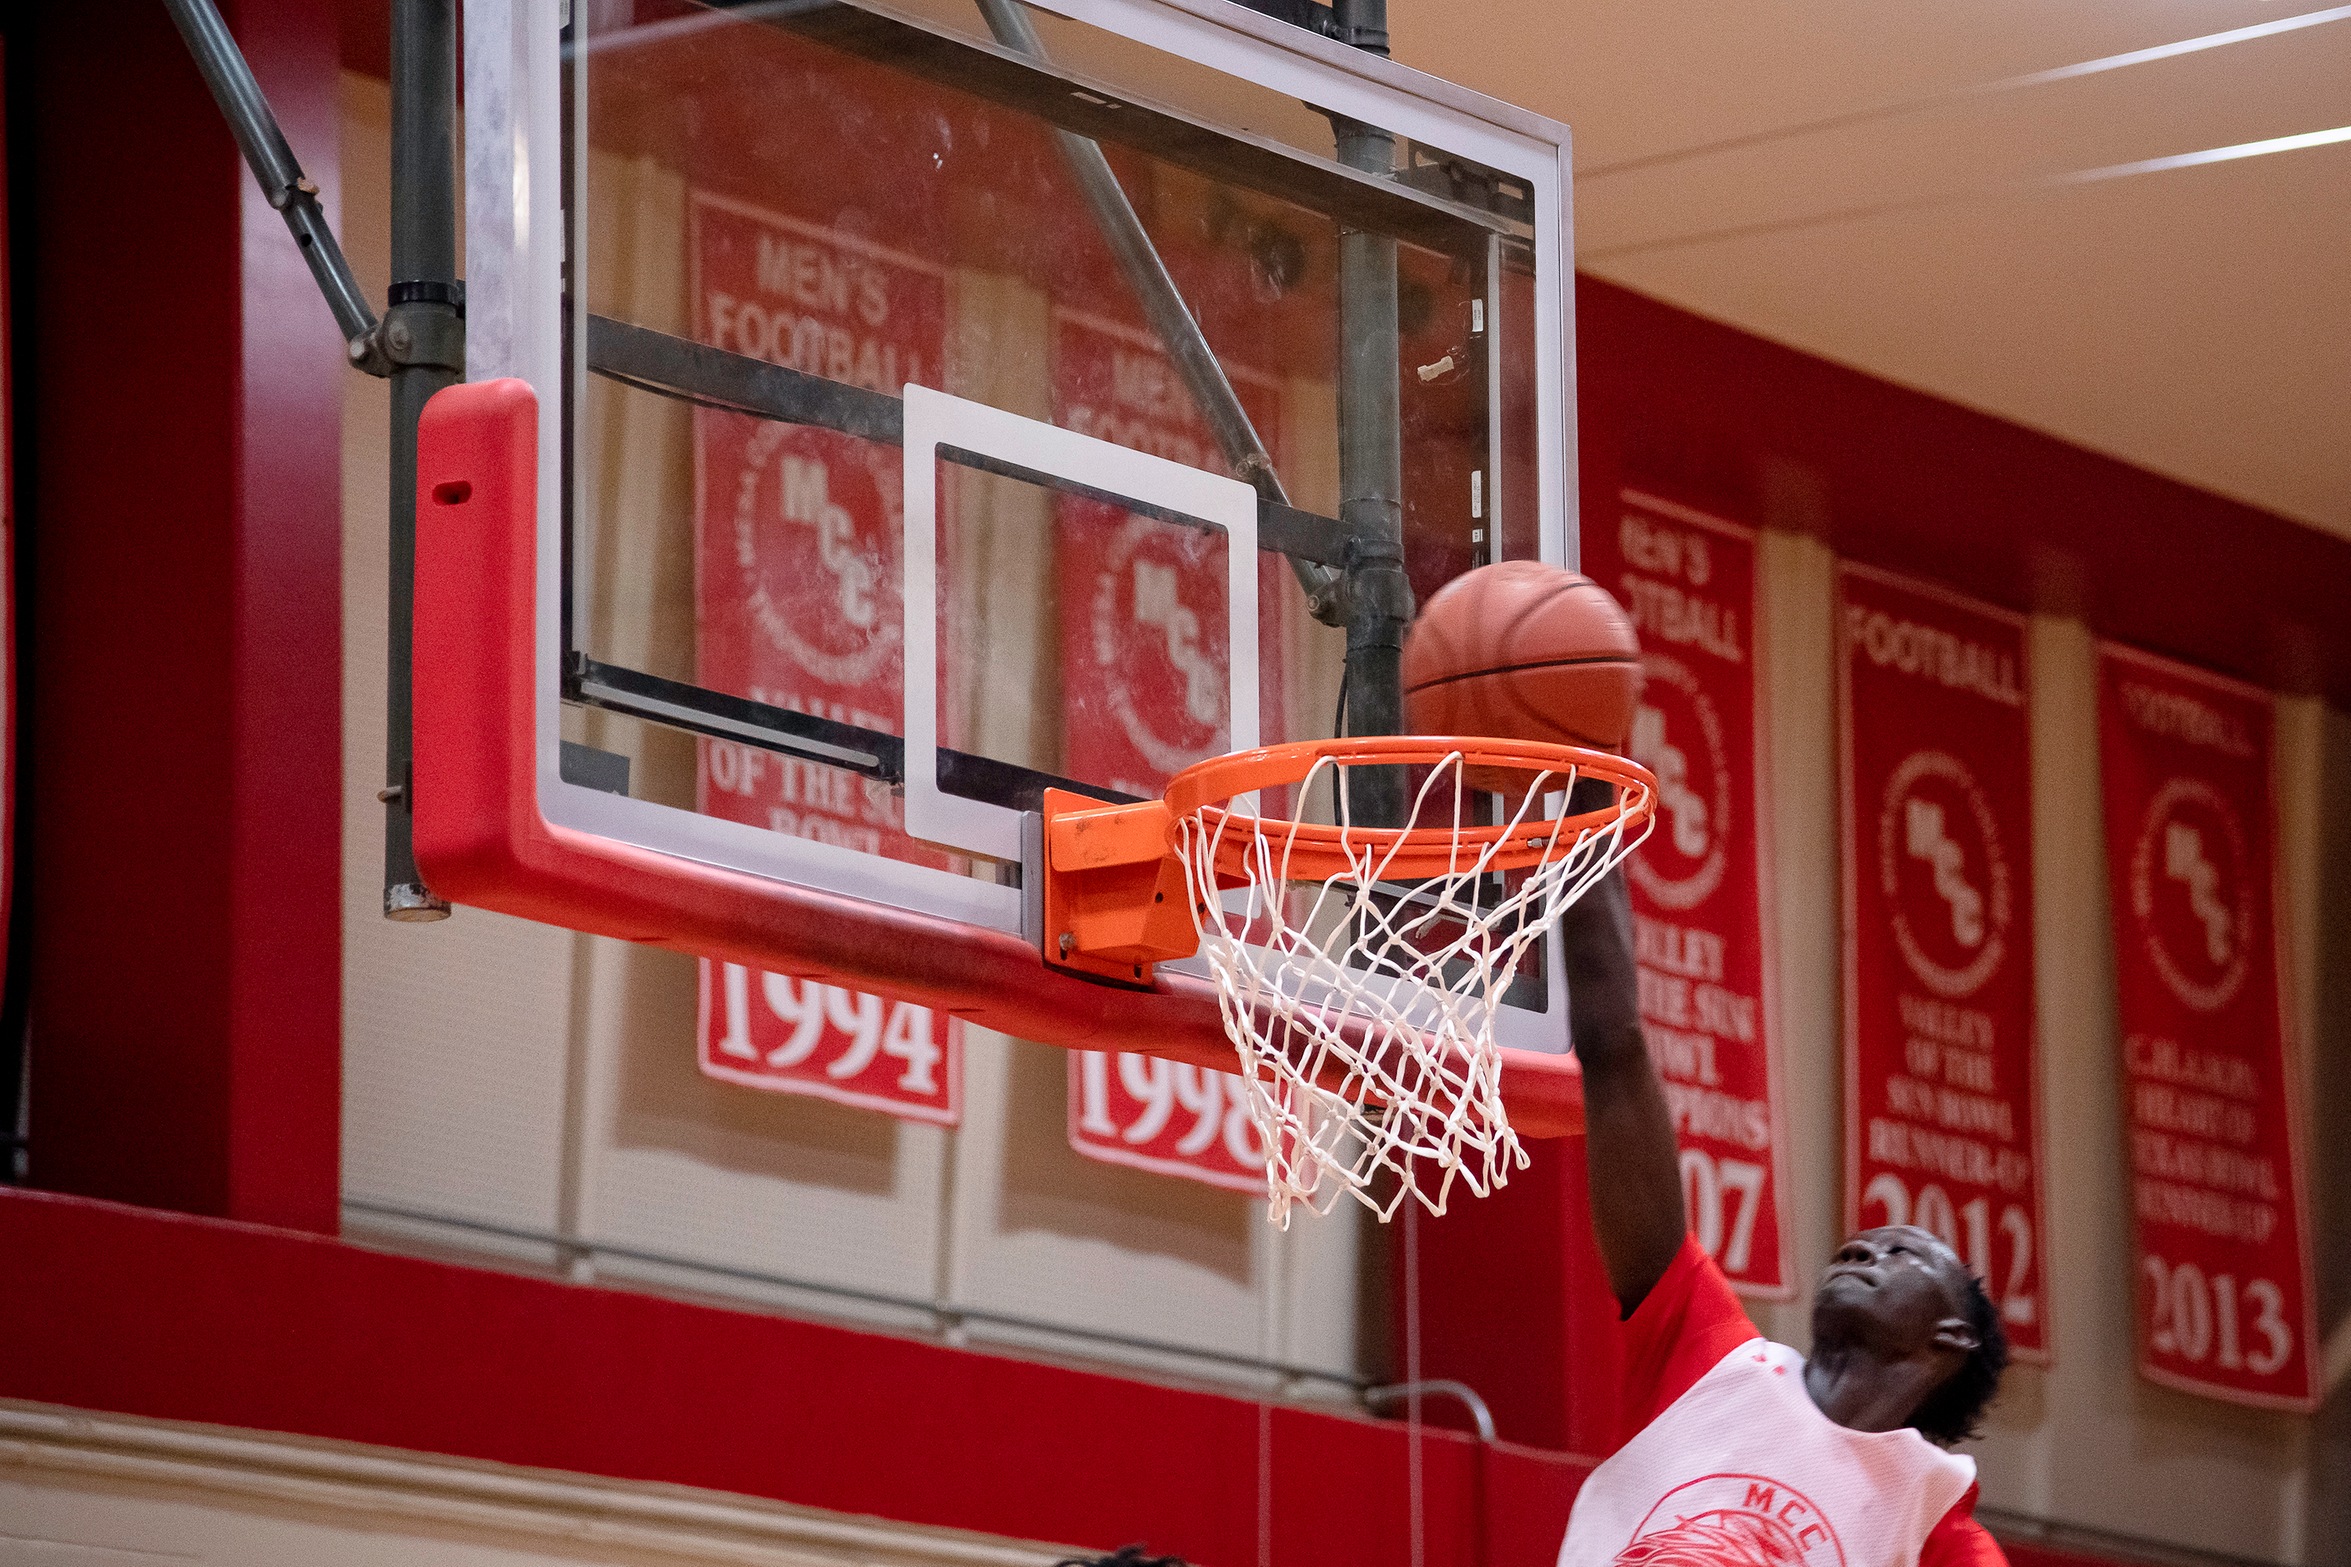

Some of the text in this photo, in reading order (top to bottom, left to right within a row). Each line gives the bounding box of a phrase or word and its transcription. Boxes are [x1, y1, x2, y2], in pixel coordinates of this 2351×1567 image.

[755, 233, 891, 328] MEN'S
[1847, 605, 2023, 706] FOOTBALL
[719, 961, 942, 1096] 1994
[1081, 1051, 1276, 1170] 1998
[1680, 1147, 1766, 1274] 07
[2143, 1254, 2294, 1376] 2013
[1743, 1483, 1828, 1552] MCC
